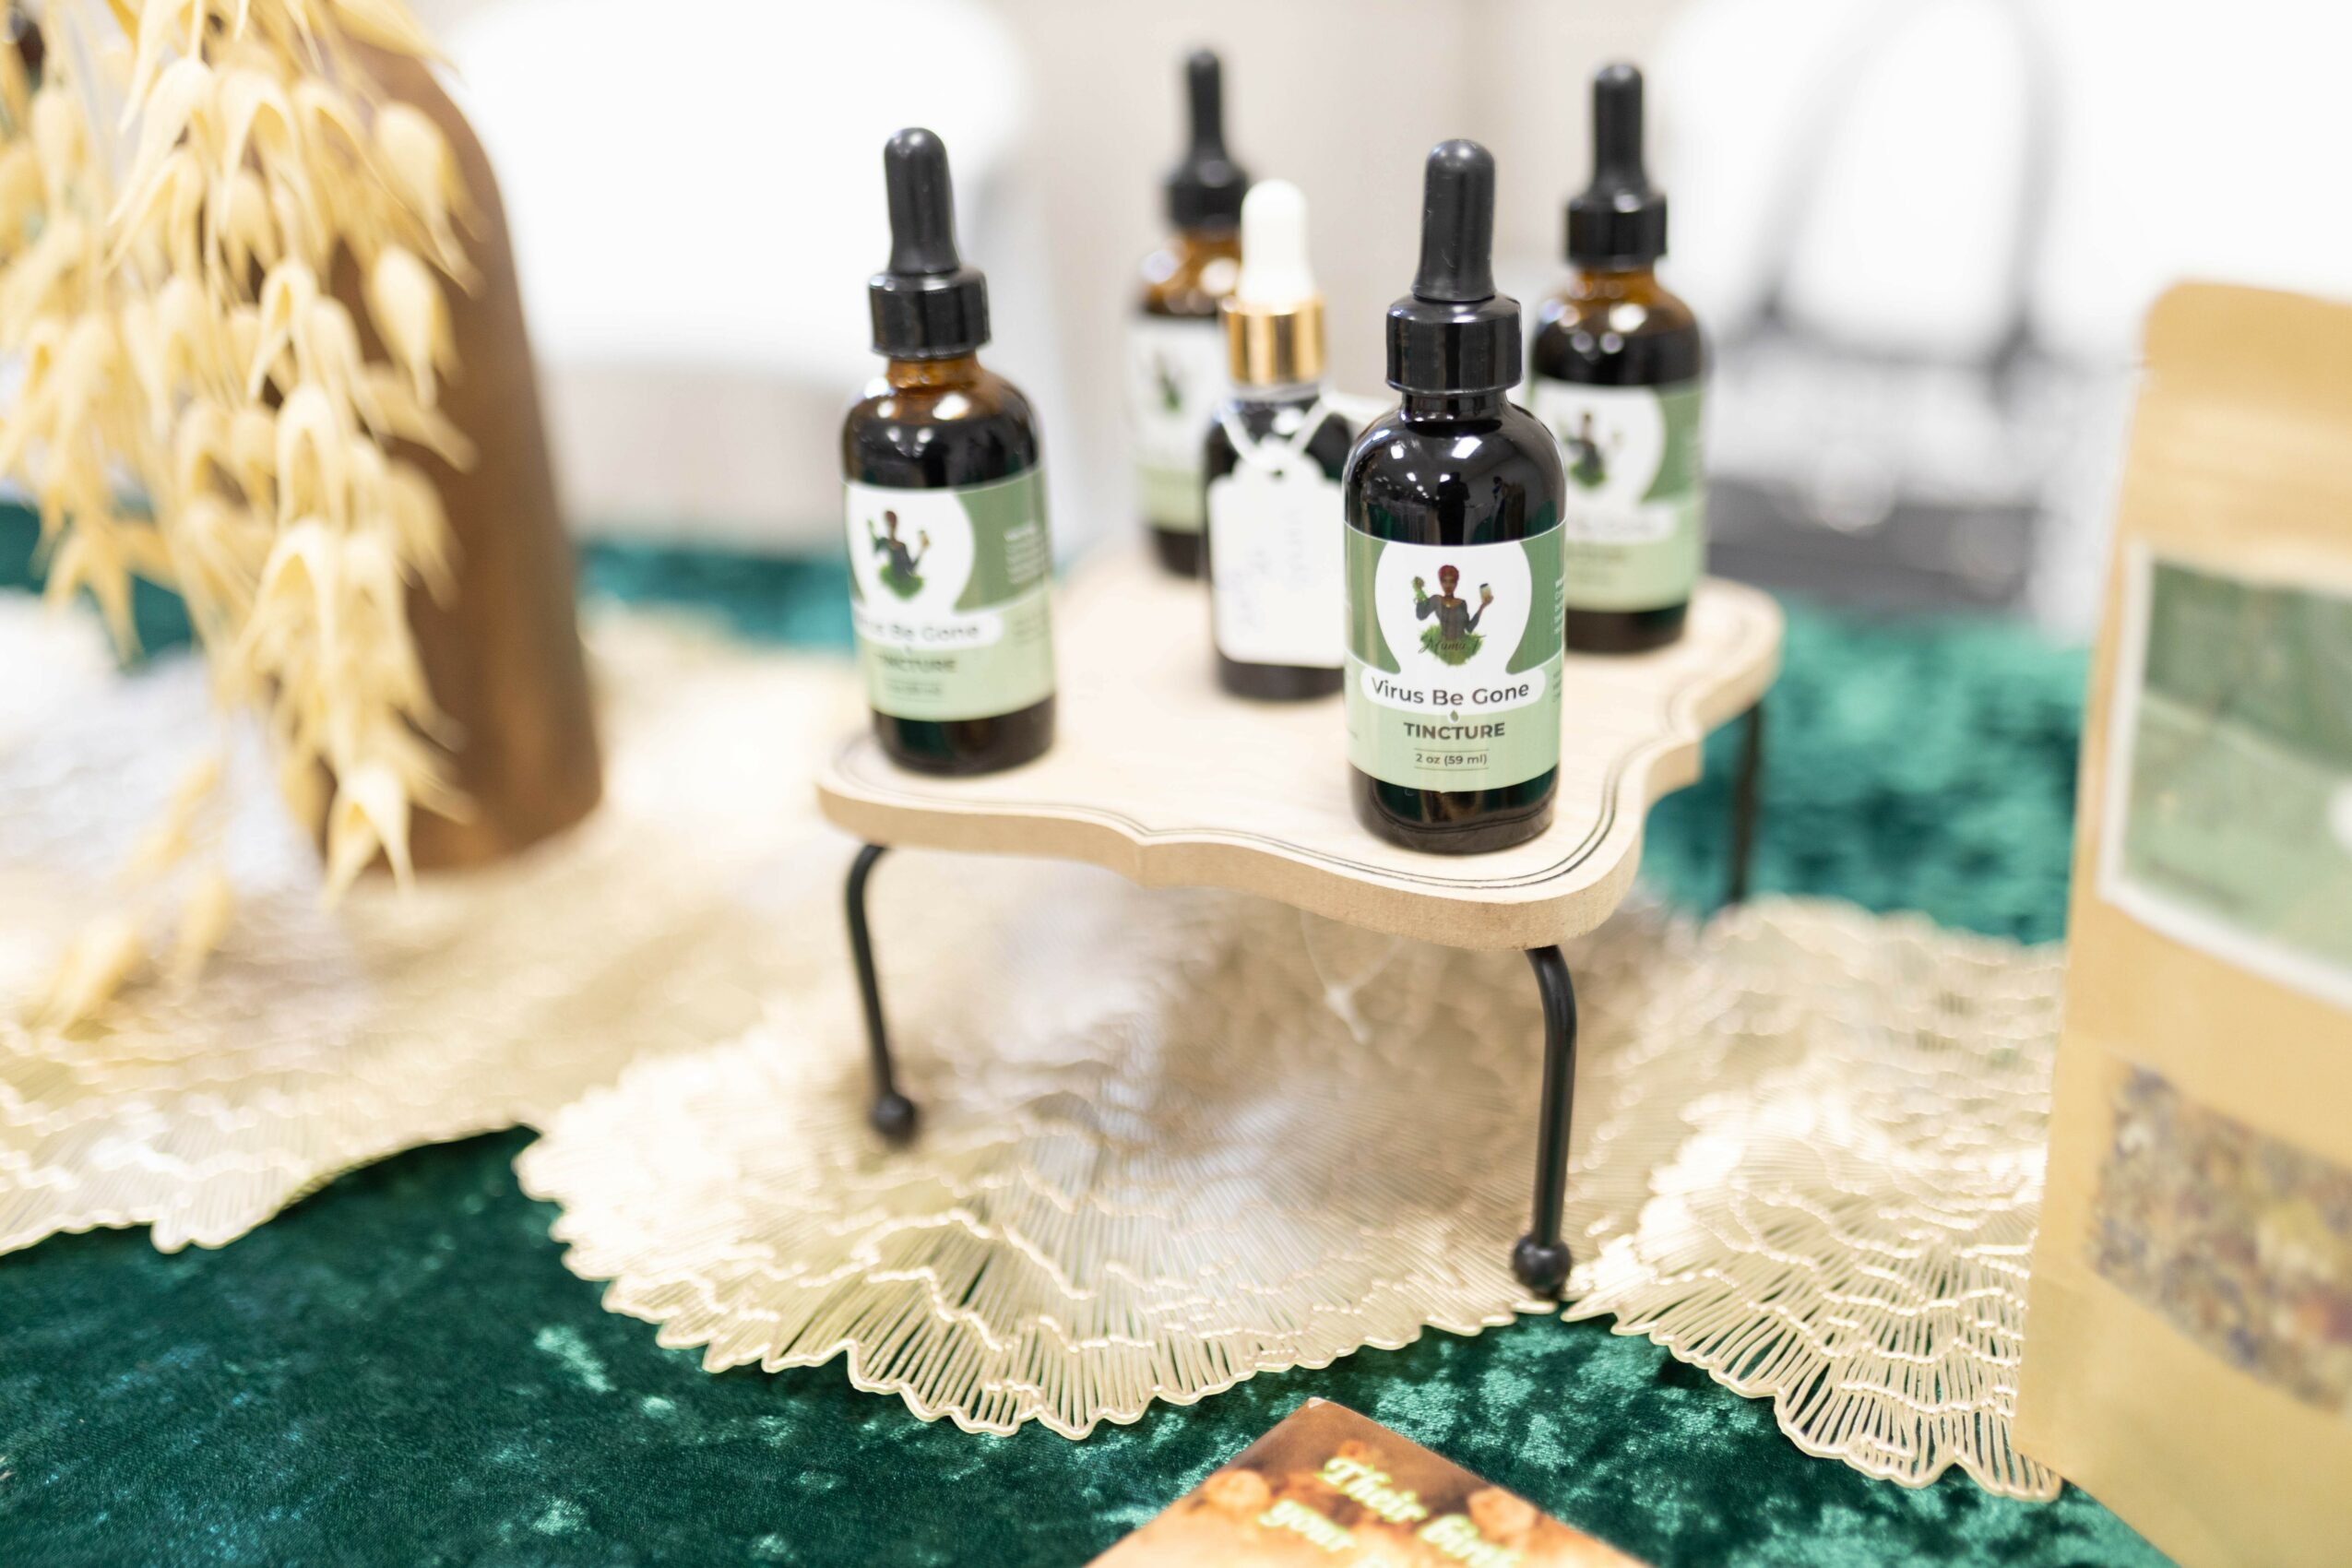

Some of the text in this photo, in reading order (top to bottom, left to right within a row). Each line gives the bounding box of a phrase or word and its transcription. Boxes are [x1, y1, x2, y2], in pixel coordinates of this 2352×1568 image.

[1372, 676, 1425, 705] Virus
[1432, 689, 1464, 706] Be
[1472, 683, 1530, 706] Gone
[1403, 722, 1506, 741] TINCTURE
[1416, 753, 1488, 767] 2 oz (59 ml)
